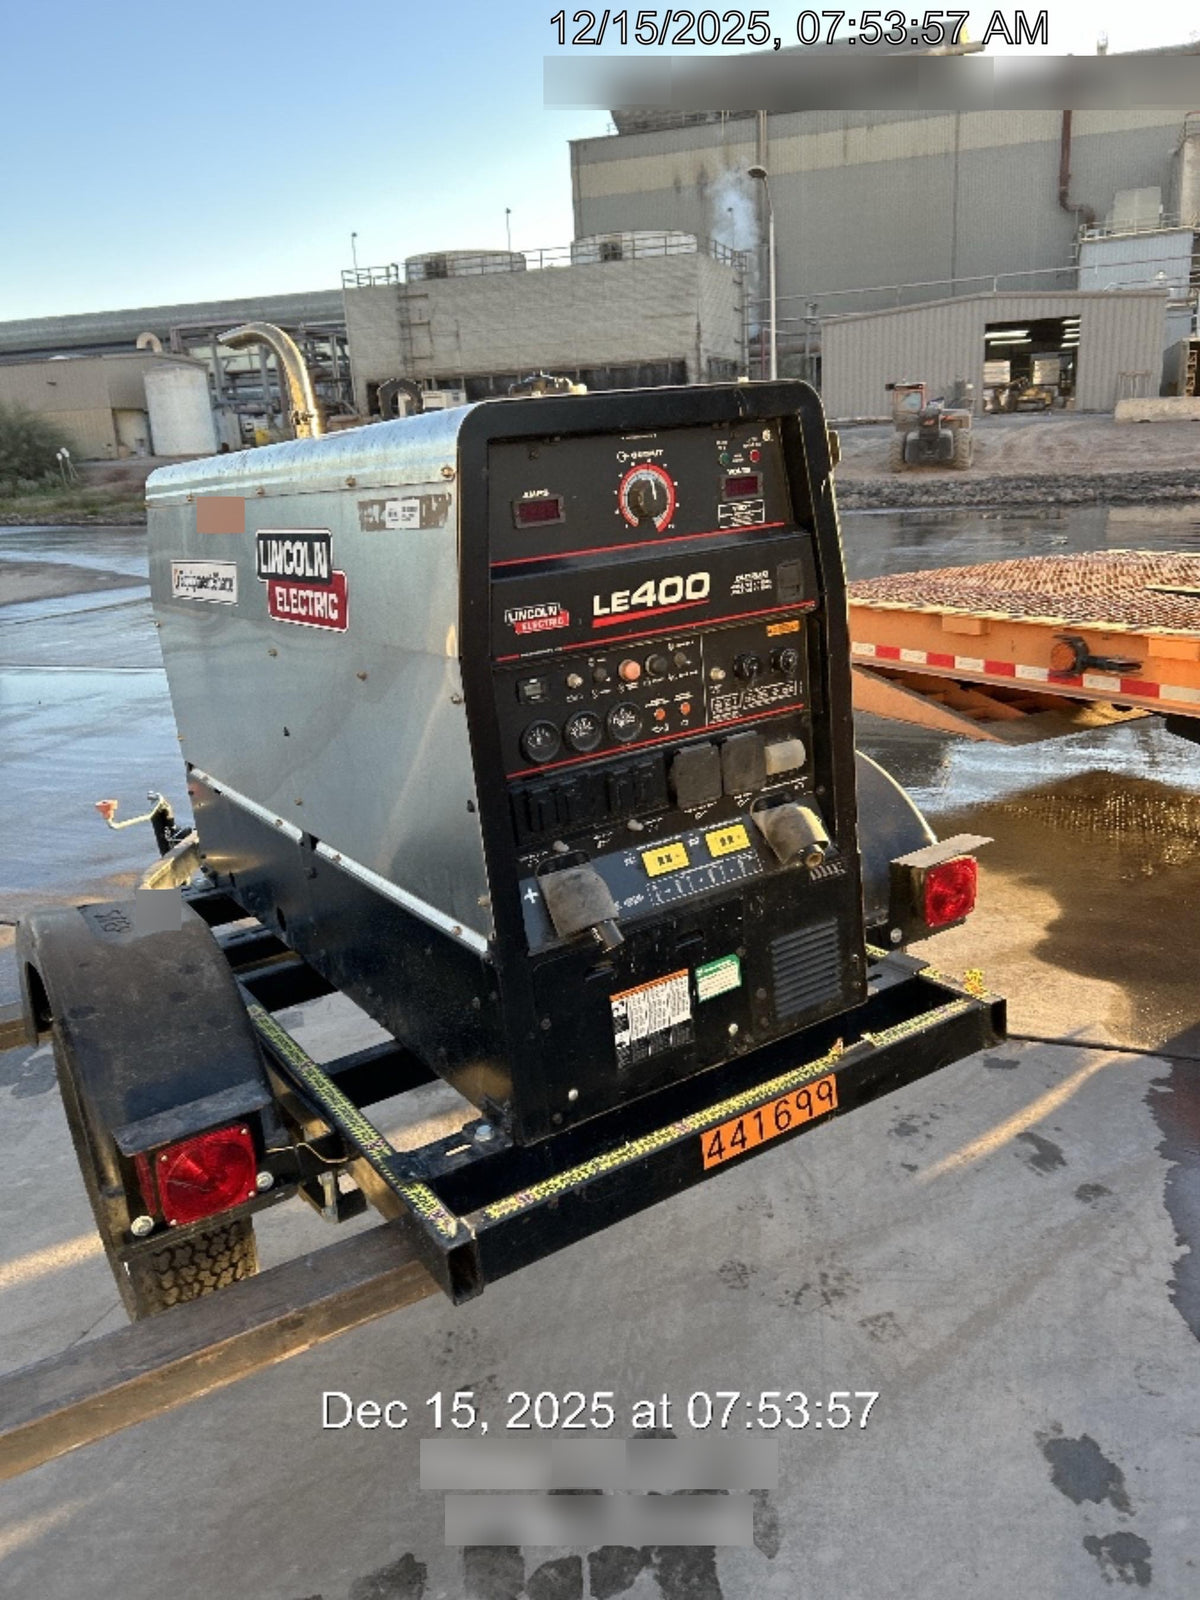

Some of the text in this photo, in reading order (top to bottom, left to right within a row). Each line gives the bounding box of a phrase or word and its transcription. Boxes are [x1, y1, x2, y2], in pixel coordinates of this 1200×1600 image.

[257, 539, 329, 579] LINCOLN
[274, 585, 340, 621] ELECTRIC
[592, 571, 711, 617] LE400
[507, 605, 558, 622] LINCOLN
[522, 616, 565, 630] ELECTRIC
[706, 1080, 835, 1160] 441699
